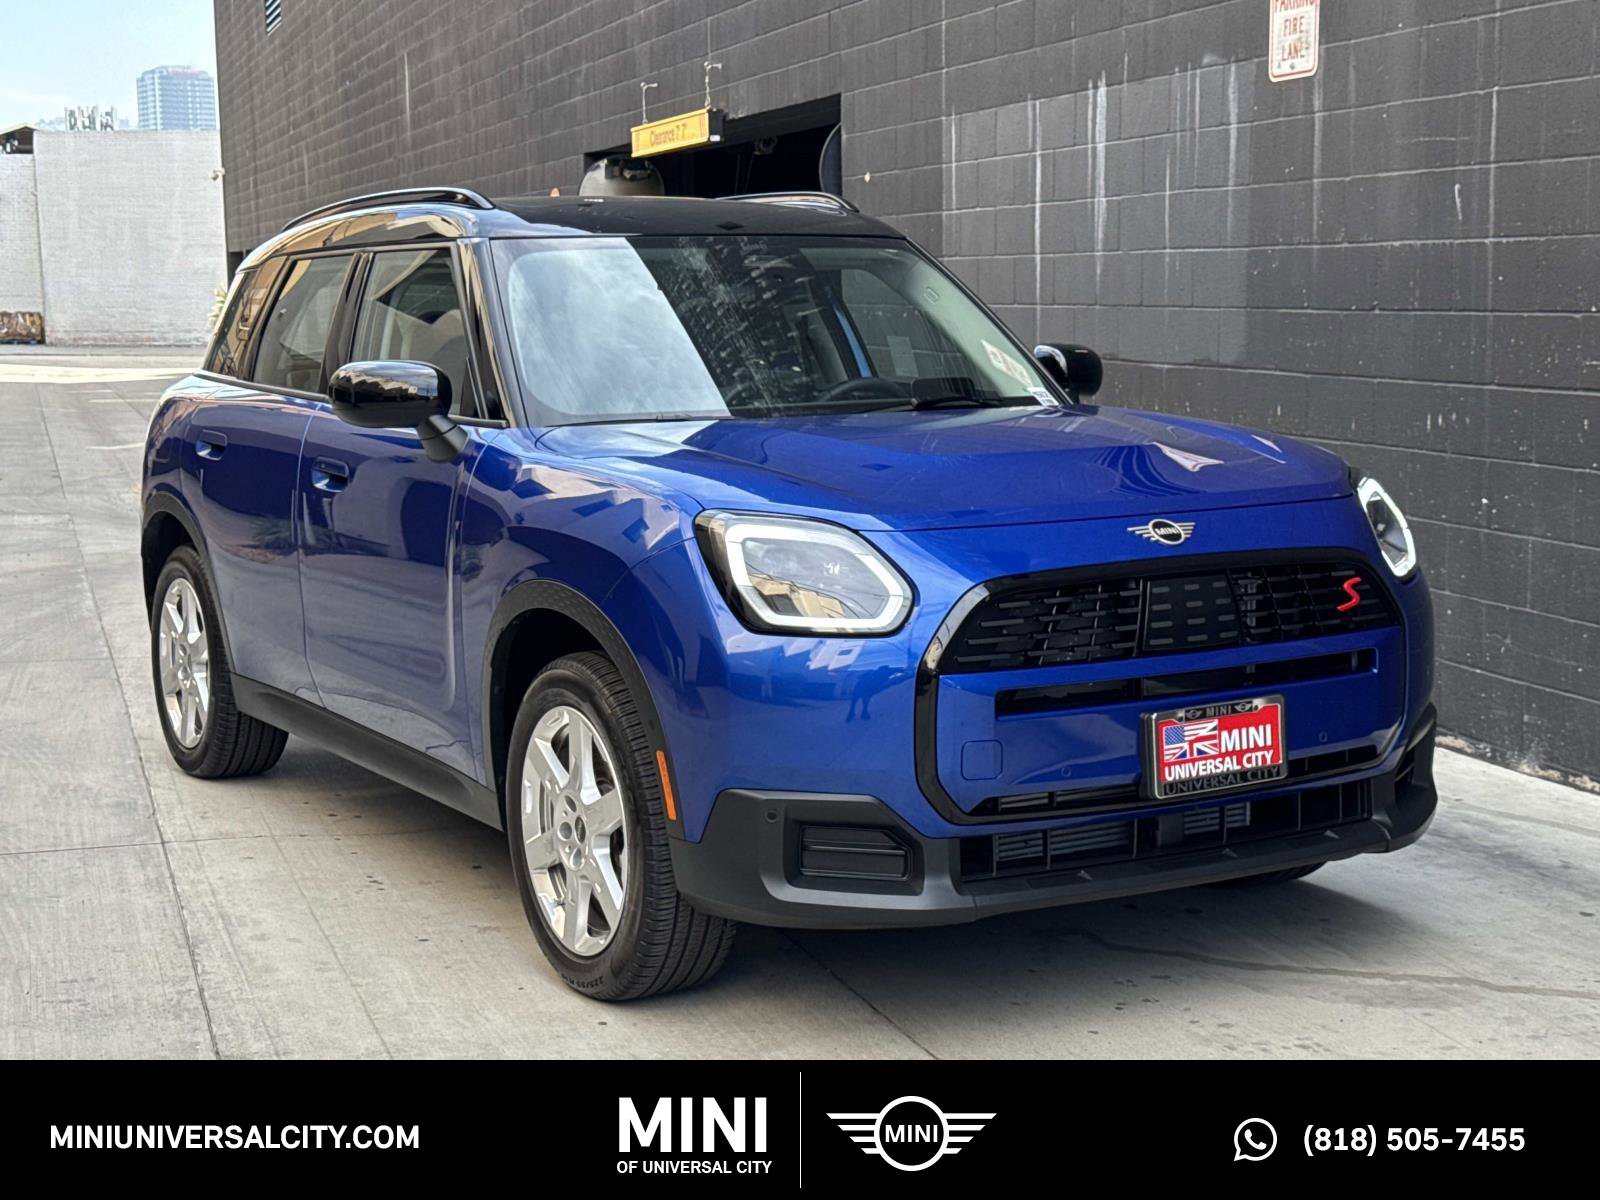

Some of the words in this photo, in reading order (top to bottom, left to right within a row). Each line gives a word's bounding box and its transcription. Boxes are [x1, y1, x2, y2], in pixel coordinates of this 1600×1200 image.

[1275, 0, 1314, 12] PARK
[1283, 16, 1305, 37] FIRE
[1155, 527, 1180, 535] MINI
[1336, 577, 1361, 611] S
[1206, 704, 1232, 717] MINI
[1221, 724, 1272, 753] MINI
[1165, 755, 1241, 781] UNIVERSAL
[1242, 750, 1274, 768] CITY
[1165, 773, 1243, 795] UNIVERSAL
[1247, 766, 1279, 783] CITY
